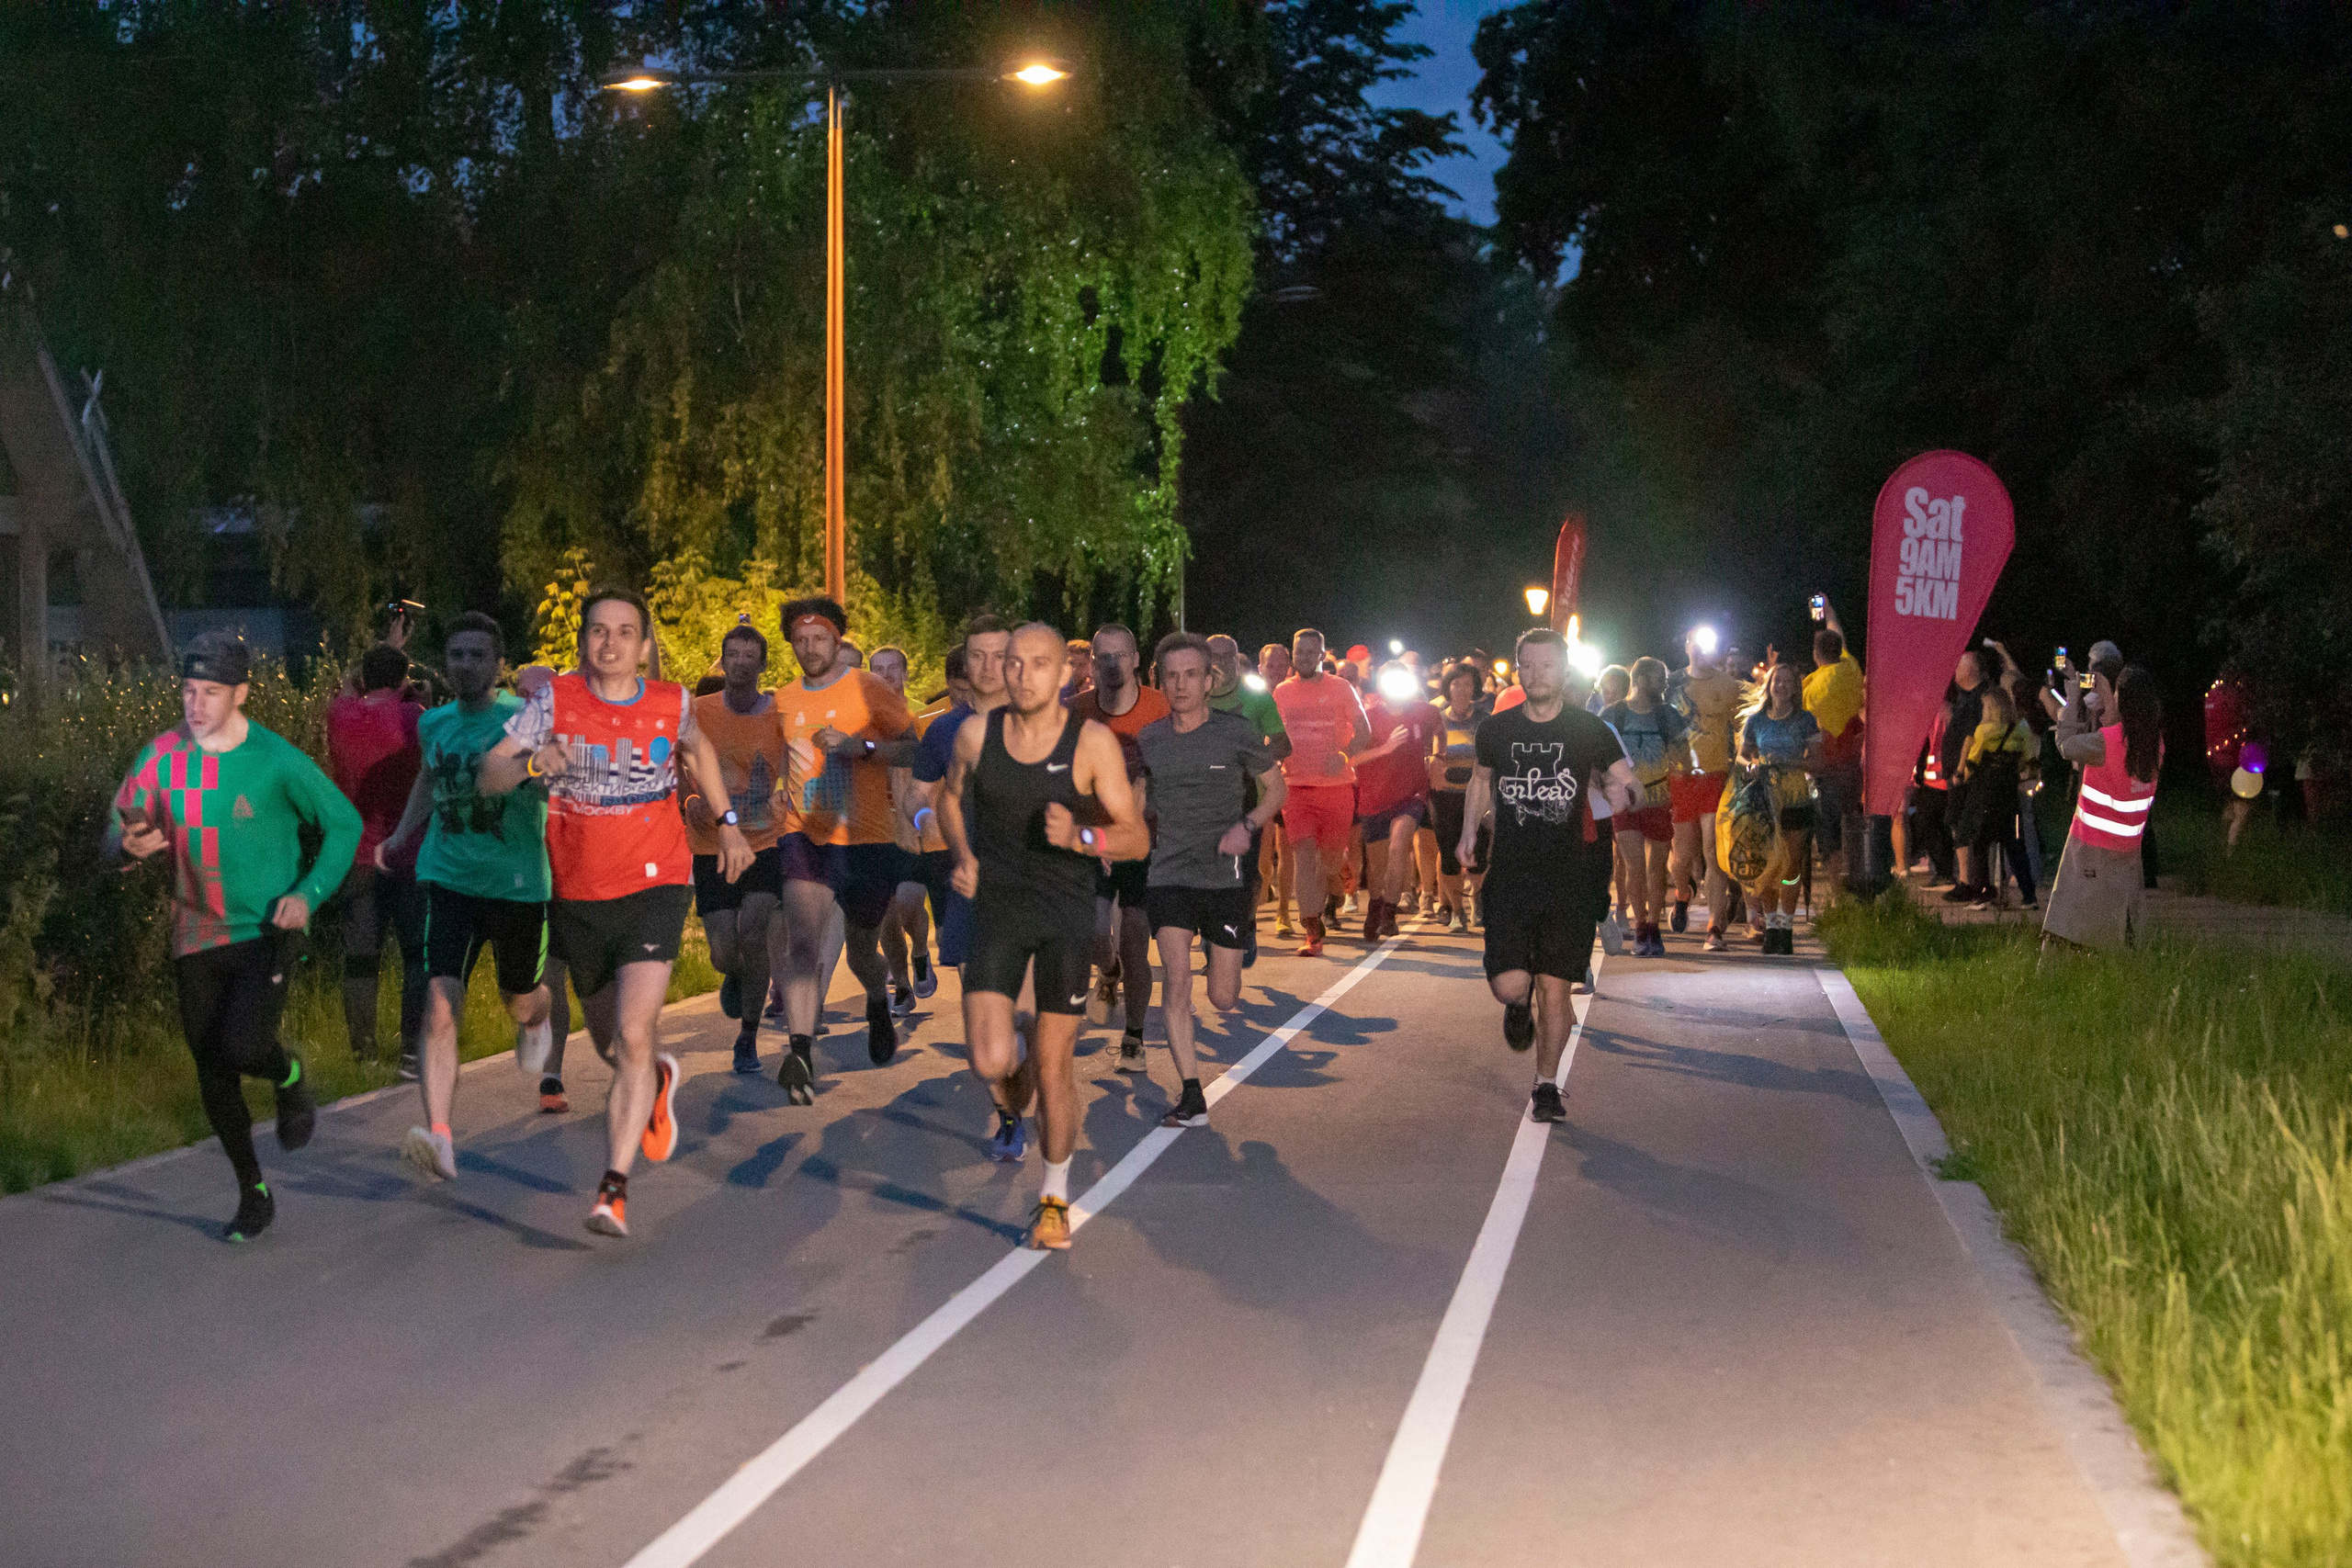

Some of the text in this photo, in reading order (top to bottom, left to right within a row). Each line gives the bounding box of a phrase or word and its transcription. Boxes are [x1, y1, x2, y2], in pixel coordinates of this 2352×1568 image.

[1903, 486, 1966, 543] Sat
[1898, 537, 1962, 581] 9AM
[1894, 576, 1959, 621] 5KM
